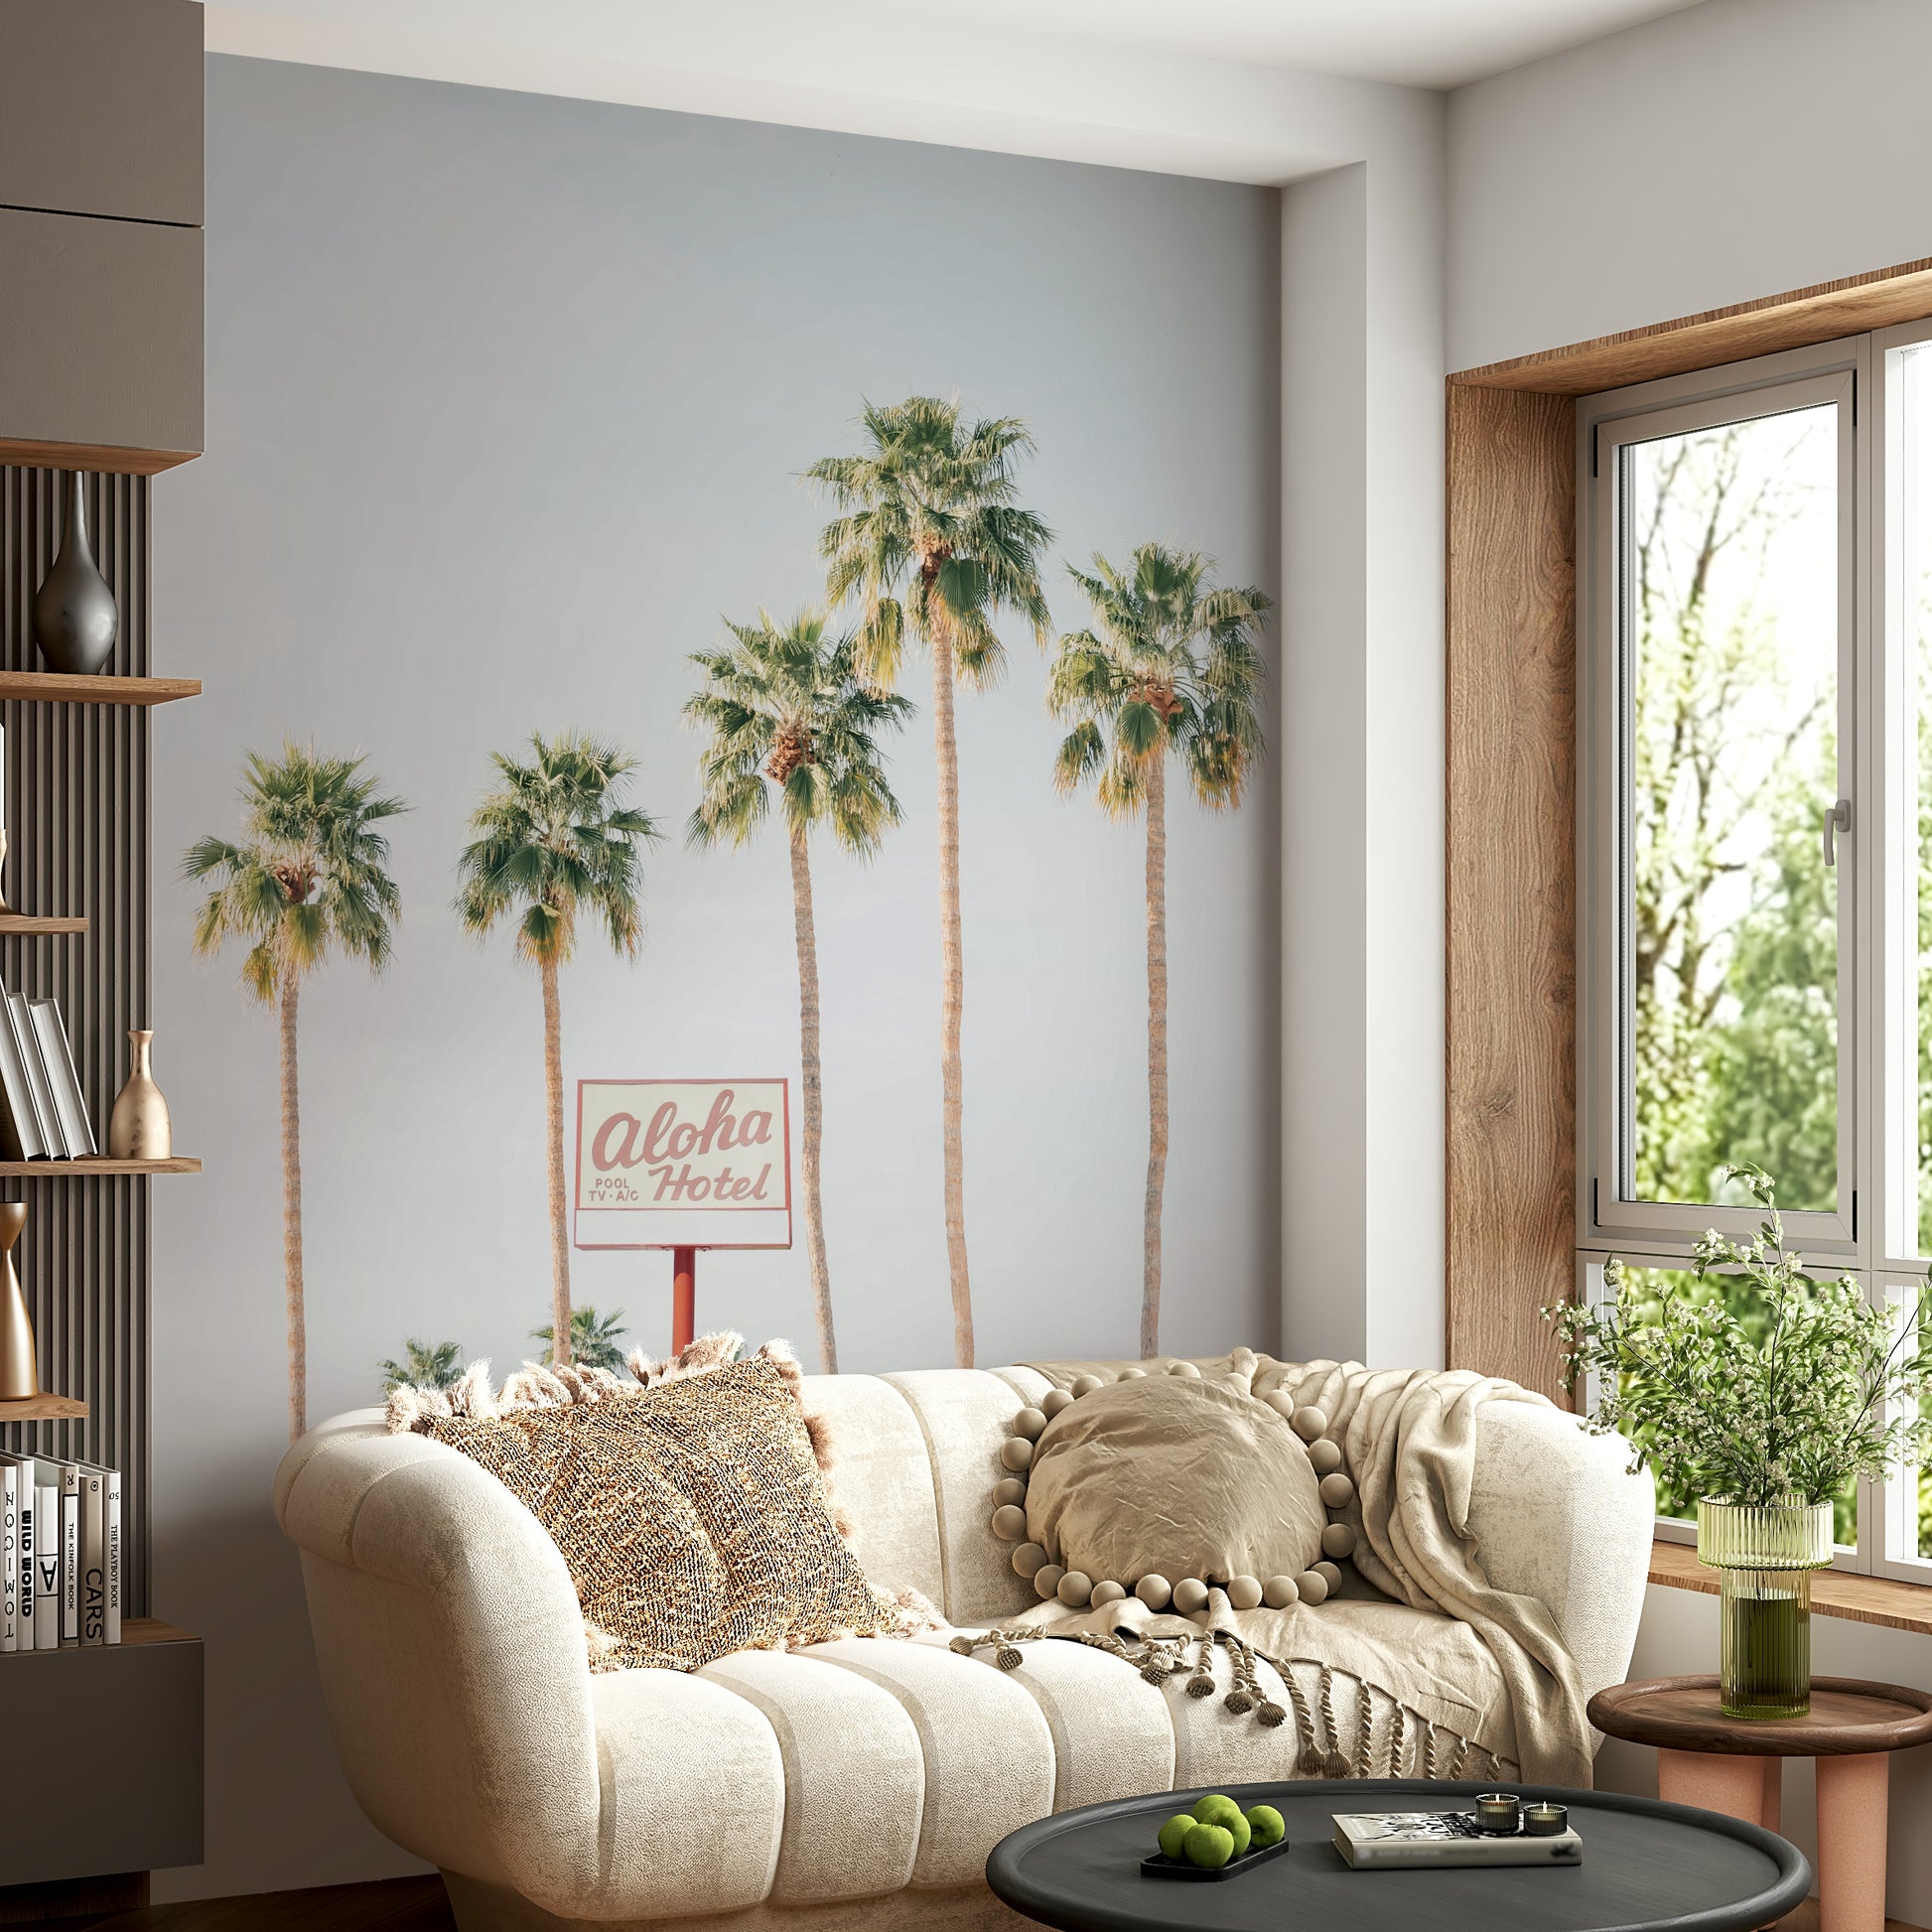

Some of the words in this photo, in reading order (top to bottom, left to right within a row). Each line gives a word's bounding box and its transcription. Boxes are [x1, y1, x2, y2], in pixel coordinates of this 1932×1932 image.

[596, 1177, 629, 1189] POOL
[648, 1164, 772, 1202] Hotel
[22, 1510, 32, 1552] WILD
[22, 1557, 32, 1617] WORLD
[40, 1561, 58, 1592] A
[85, 1568, 102, 1639] CARS
